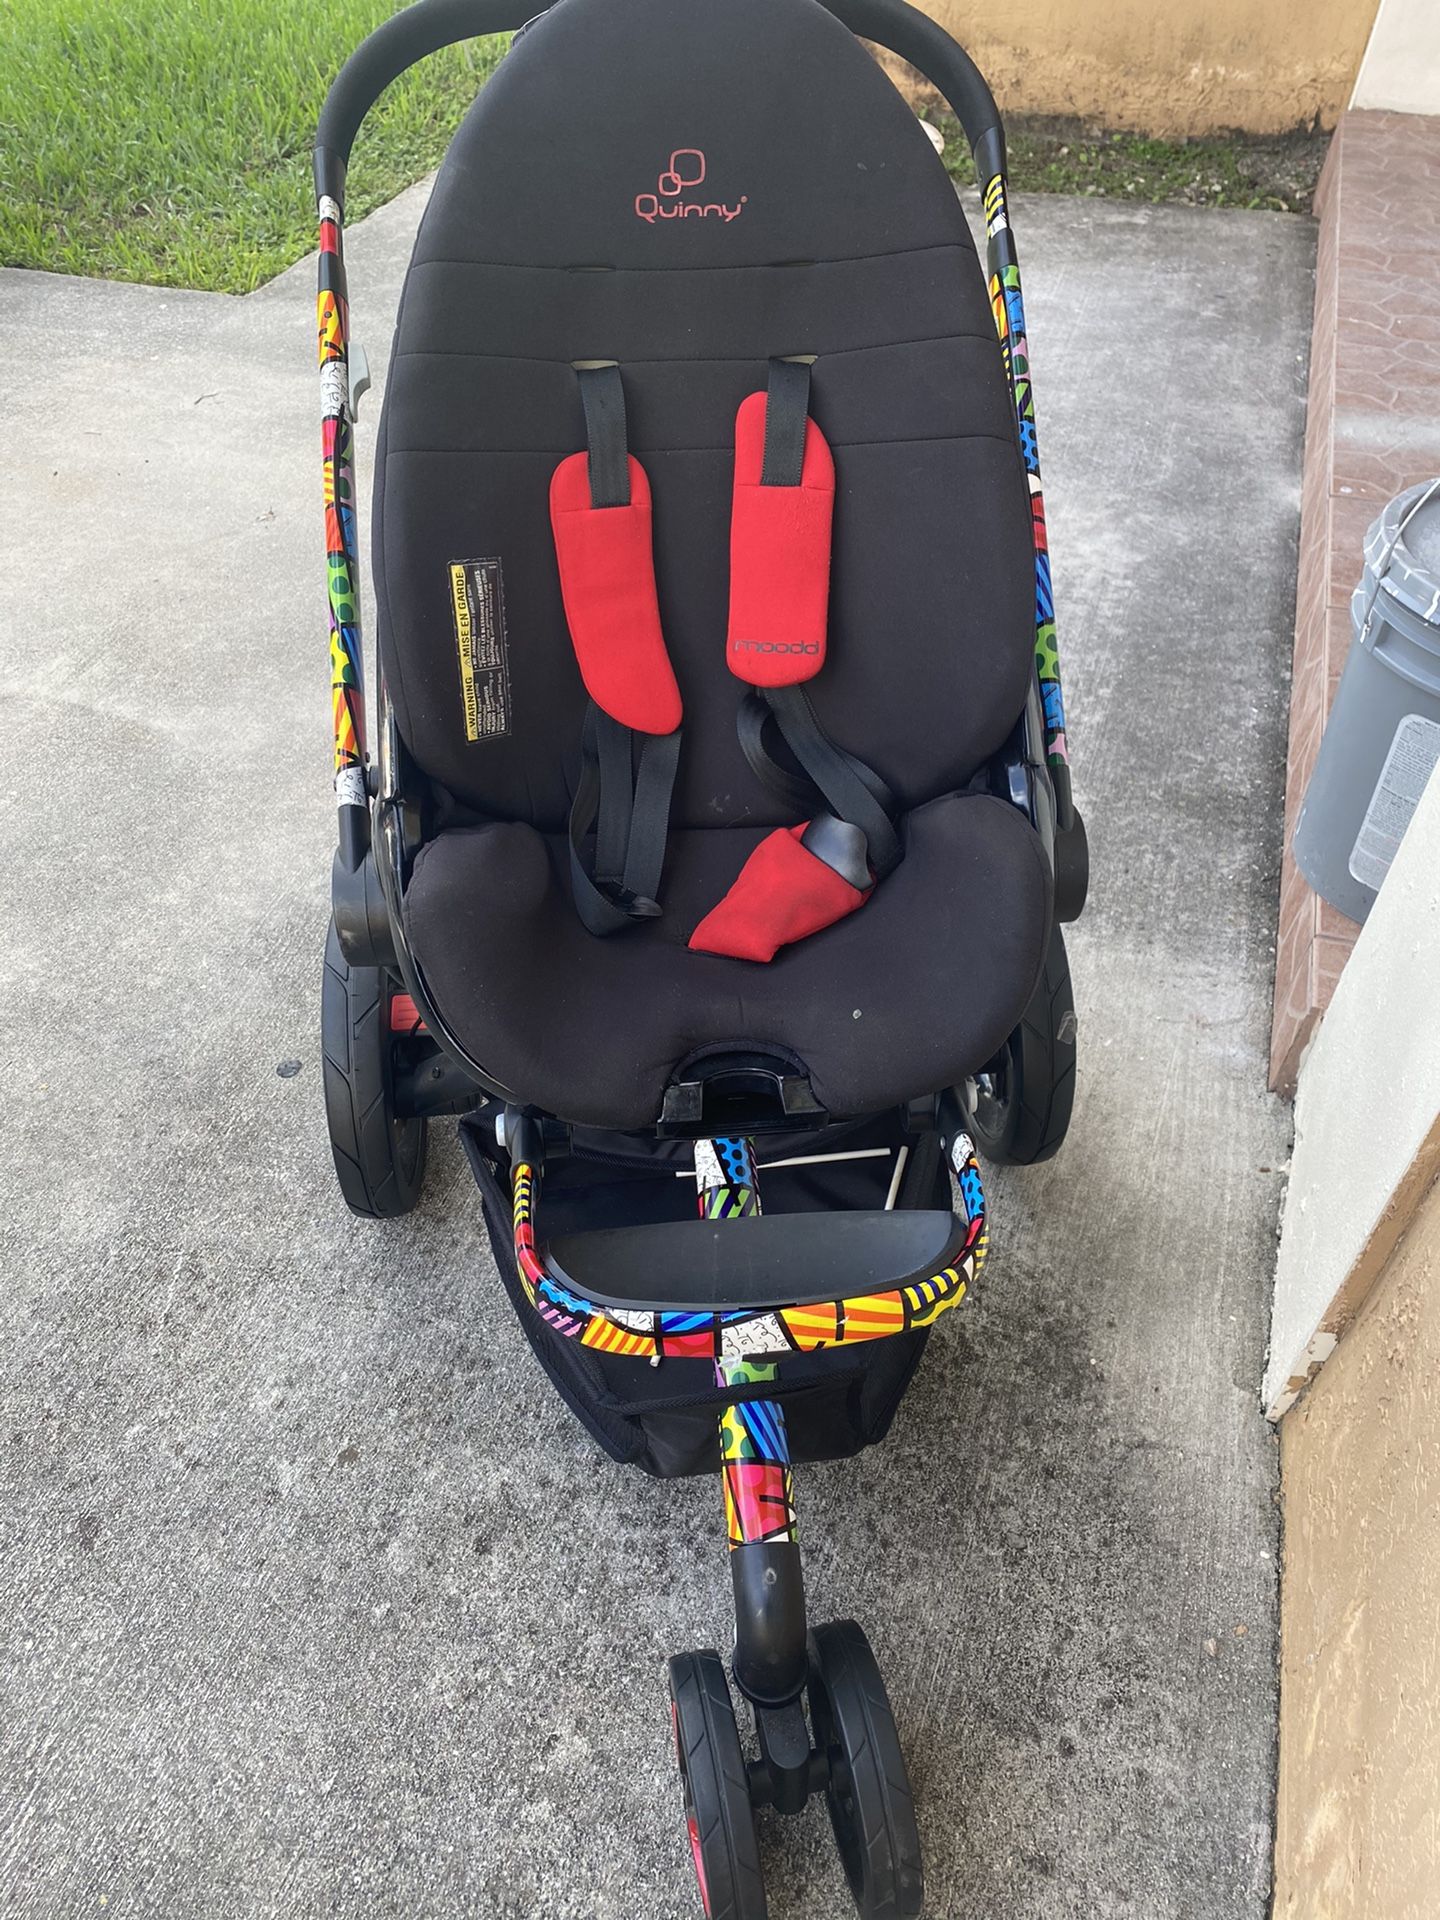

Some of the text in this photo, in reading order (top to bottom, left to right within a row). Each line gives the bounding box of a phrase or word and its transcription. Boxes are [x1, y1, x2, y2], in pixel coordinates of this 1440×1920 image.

[635, 194, 742, 223] Quinny
[456, 573, 470, 657] MISE EN GARDE
[465, 677, 474, 727] WARNING
